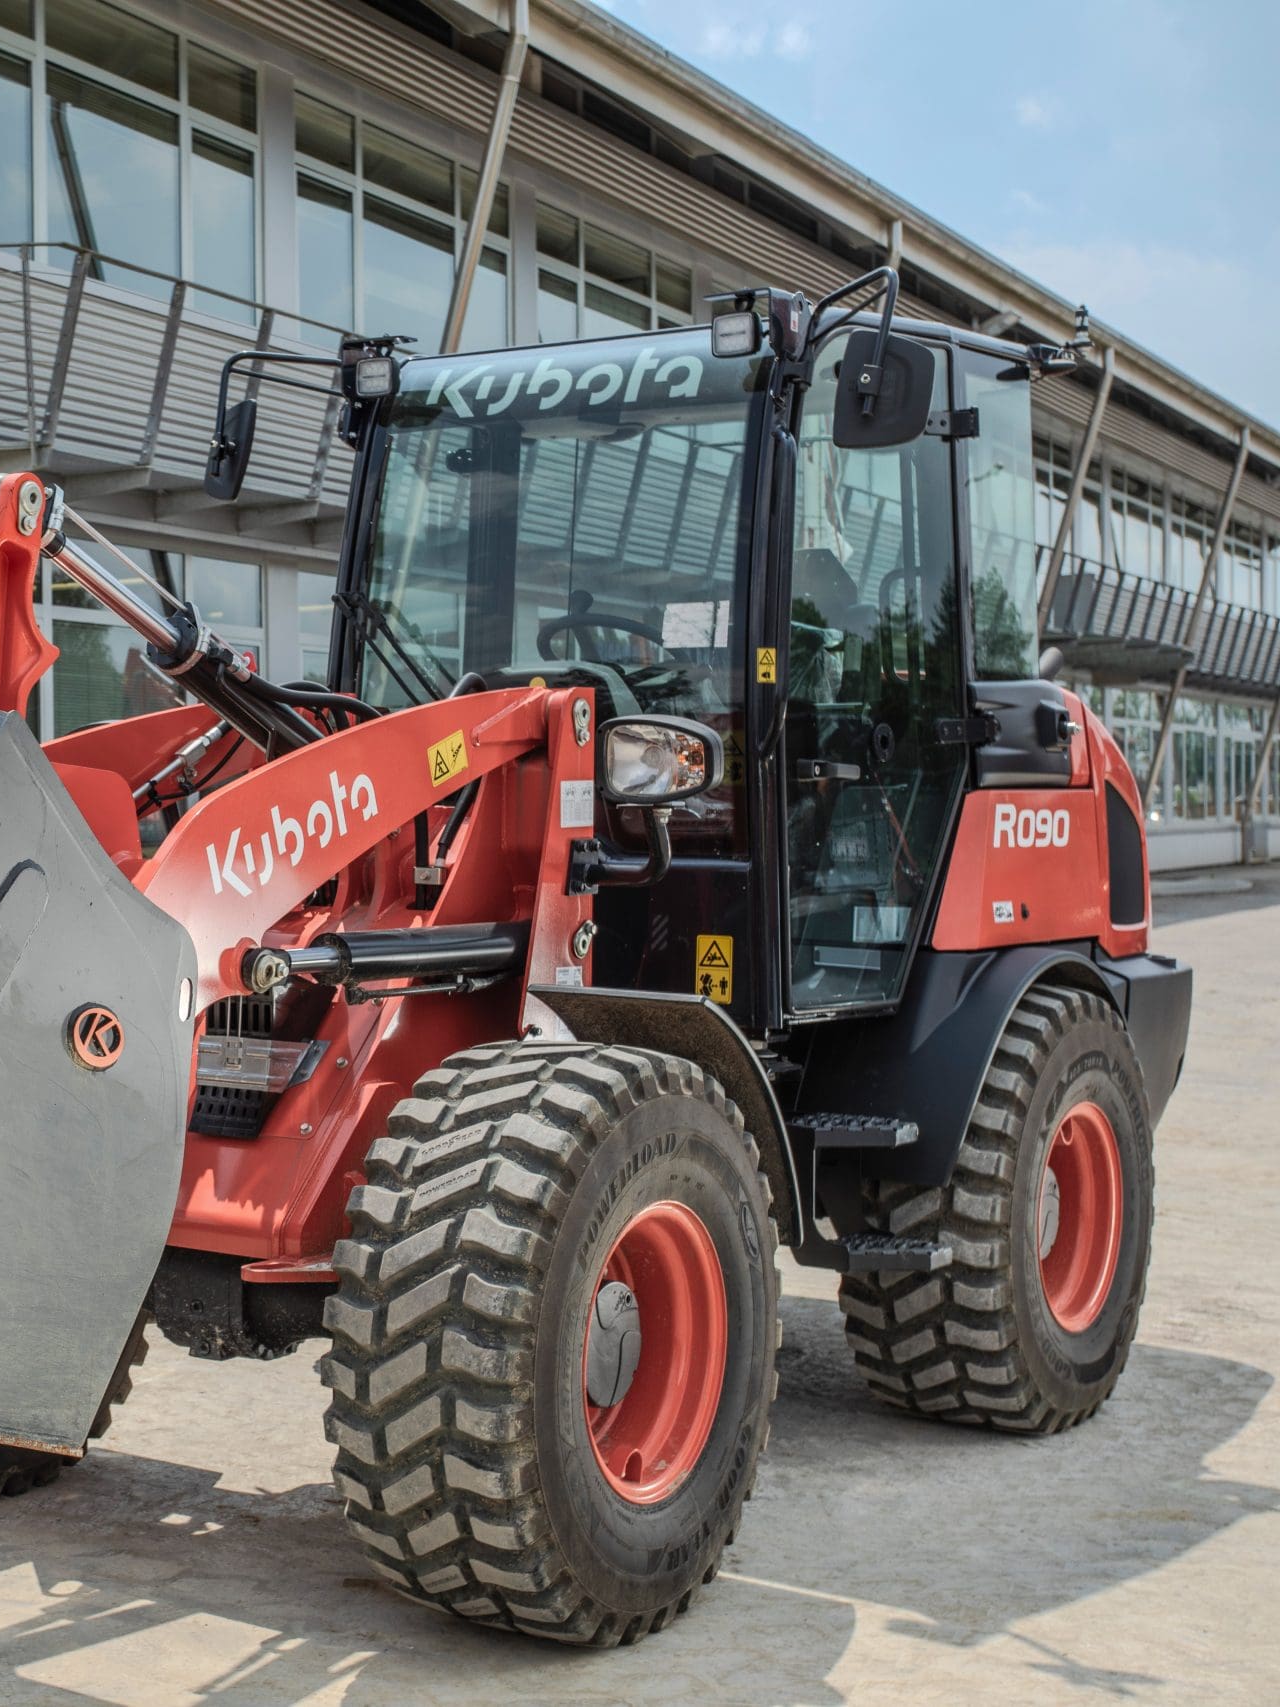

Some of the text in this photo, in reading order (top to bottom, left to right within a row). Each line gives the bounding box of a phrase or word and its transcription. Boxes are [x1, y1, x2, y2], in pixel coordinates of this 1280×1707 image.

[425, 347, 704, 418] Kubota
[206, 770, 378, 897] Kubota
[993, 803, 1070, 849] R090
[576, 1133, 677, 1273] POWERLOAD
